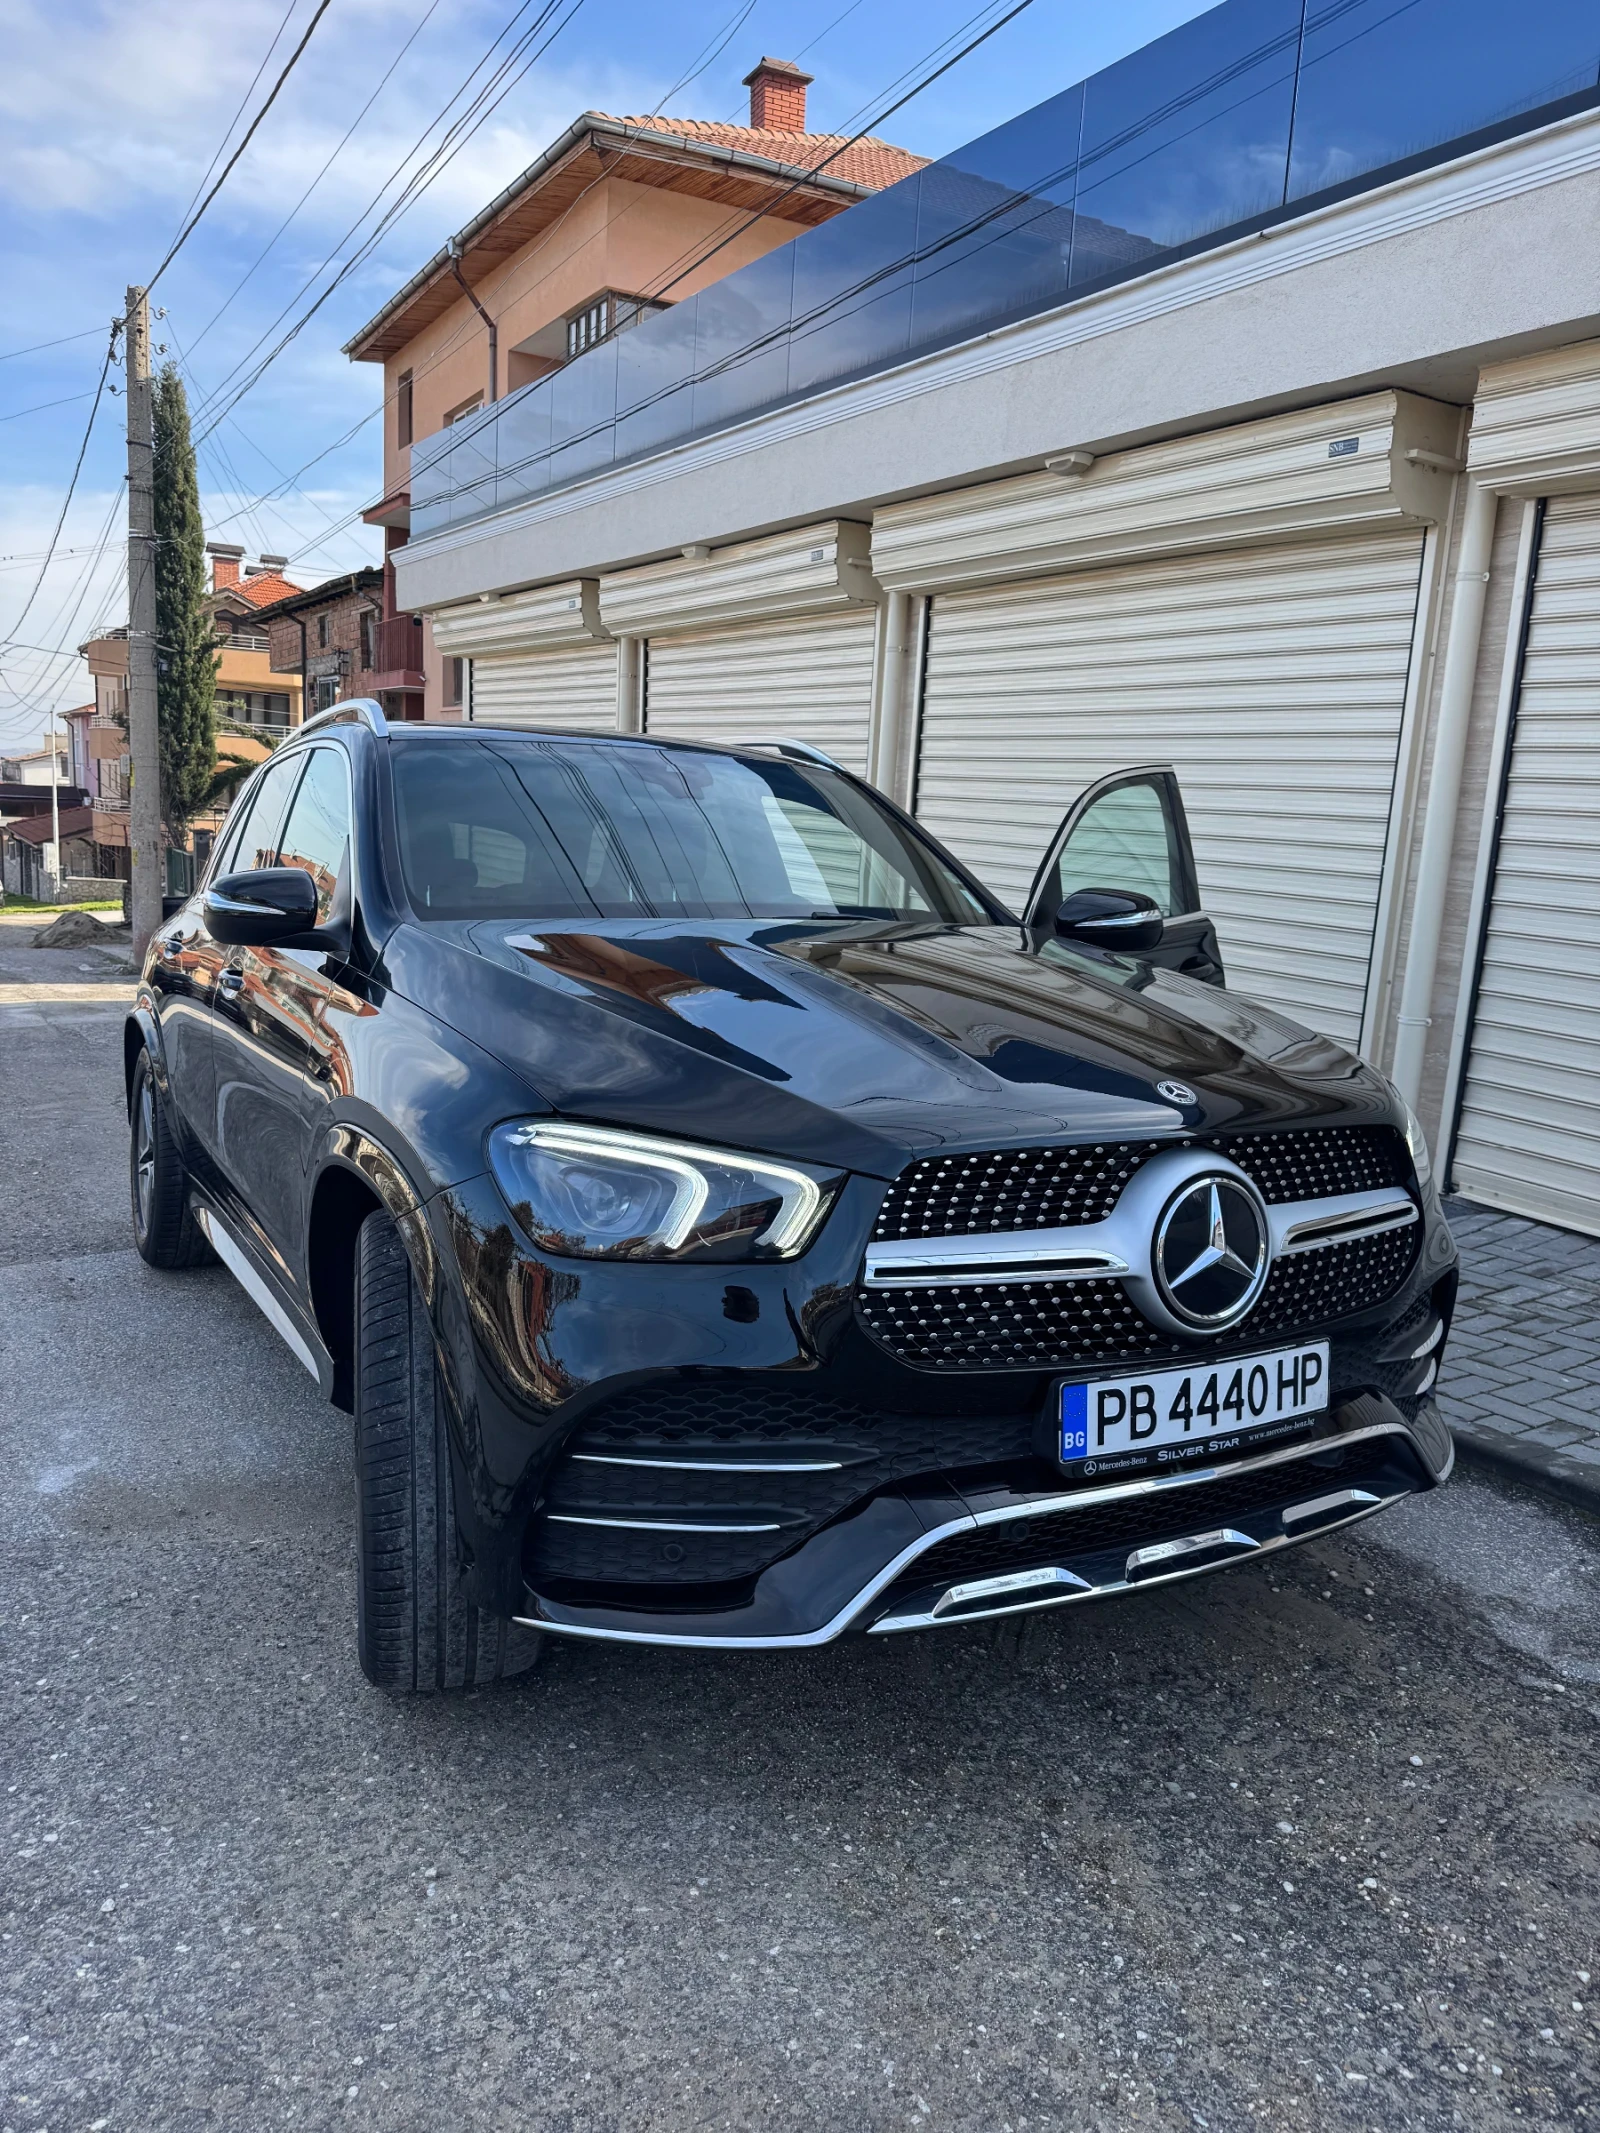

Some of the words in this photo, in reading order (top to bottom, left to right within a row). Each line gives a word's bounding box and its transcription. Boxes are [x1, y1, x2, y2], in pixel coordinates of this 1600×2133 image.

[1097, 1384, 1157, 1446] PB
[1168, 1364, 1268, 1432] 4440
[1277, 1352, 1322, 1411] HP
[1064, 1431, 1085, 1449] BG
[1099, 1456, 1147, 1471] Mercedes-Benz
[1157, 1446, 1204, 1462] SILVER
[1208, 1437, 1240, 1452] STAR
